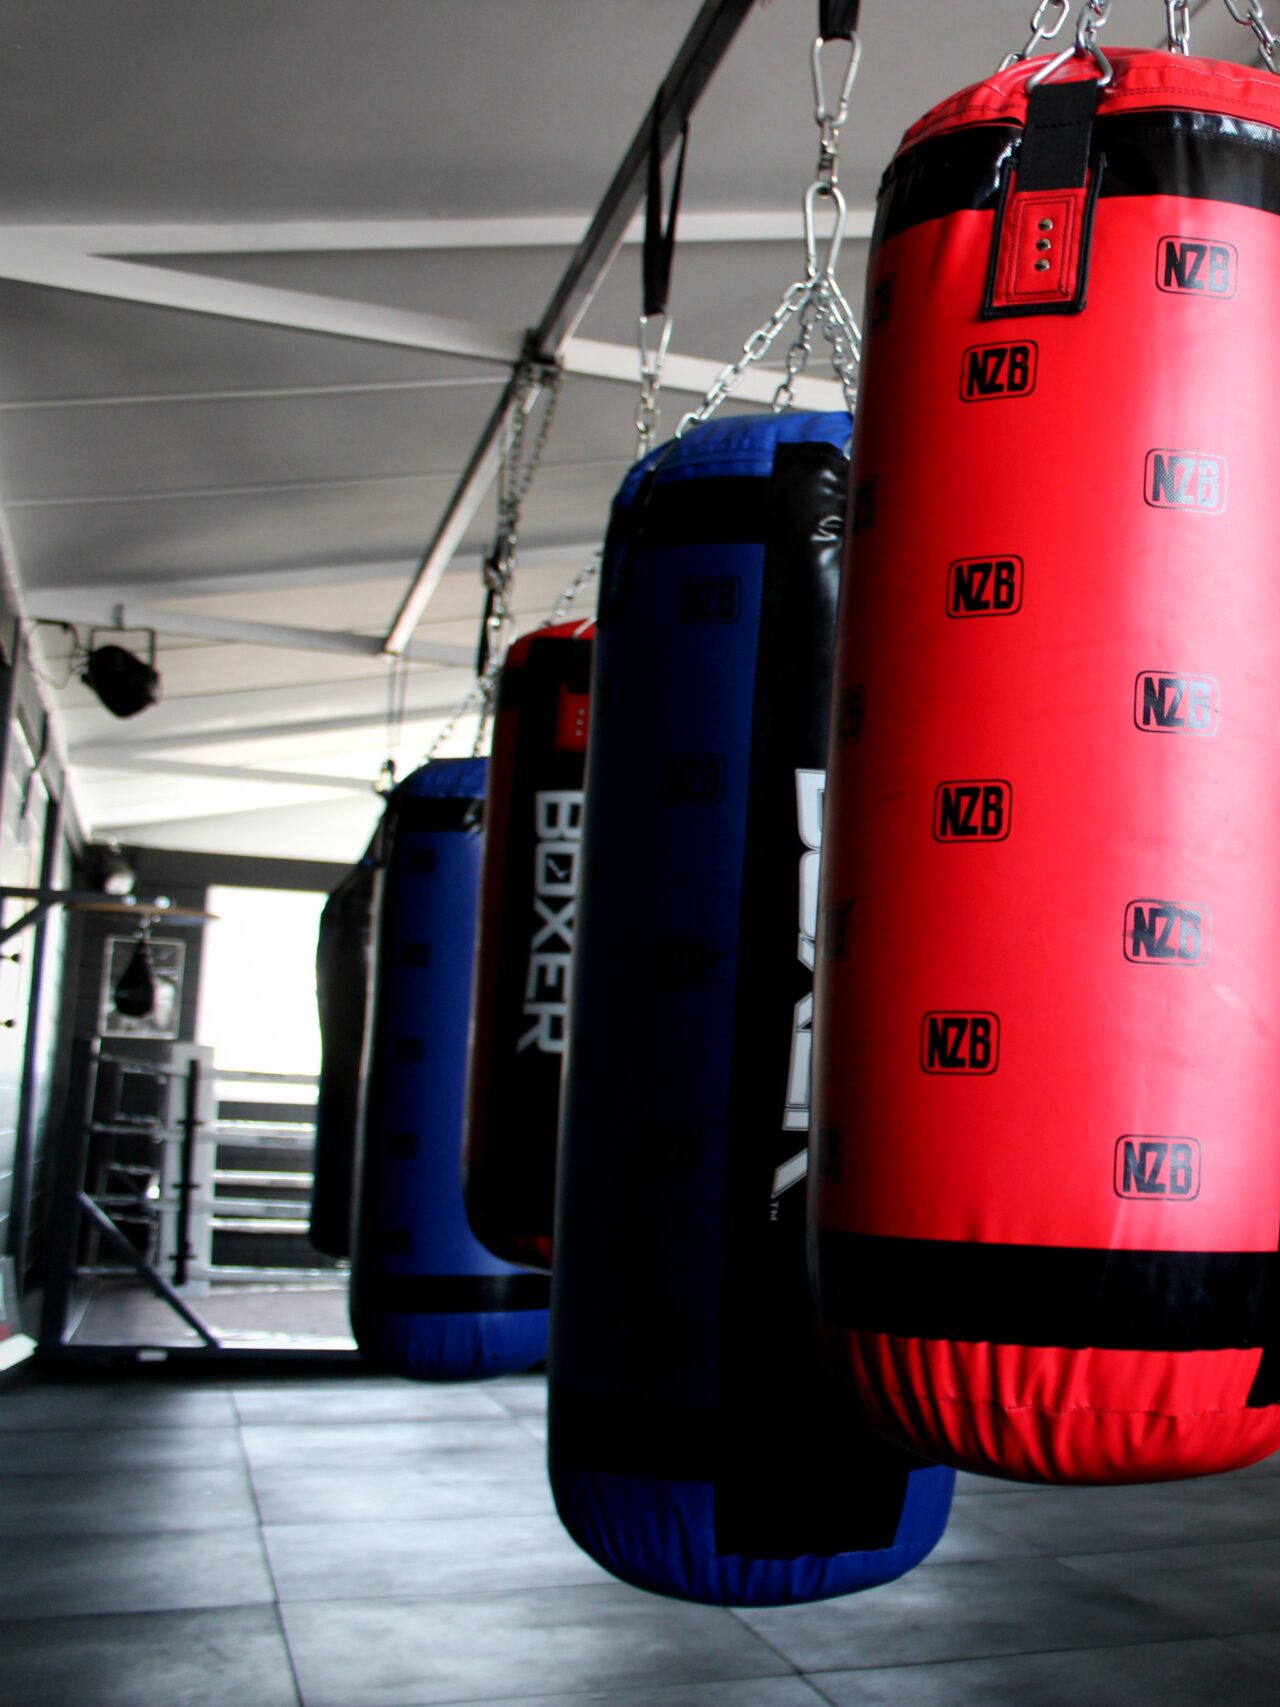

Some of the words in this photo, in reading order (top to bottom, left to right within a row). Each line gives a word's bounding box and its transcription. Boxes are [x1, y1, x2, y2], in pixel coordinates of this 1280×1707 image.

[1164, 241, 1231, 293] NZB
[967, 346, 1030, 397] NZB
[1152, 454, 1221, 508] NZB
[953, 561, 1016, 612] NZB
[1143, 676, 1210, 729] NZB
[940, 786, 1004, 837] NZB
[516, 790, 586, 1055] BOXER
[1132, 906, 1203, 960] NZB
[928, 1017, 991, 1068] NZB
[1123, 1141, 1193, 1195] NZB
